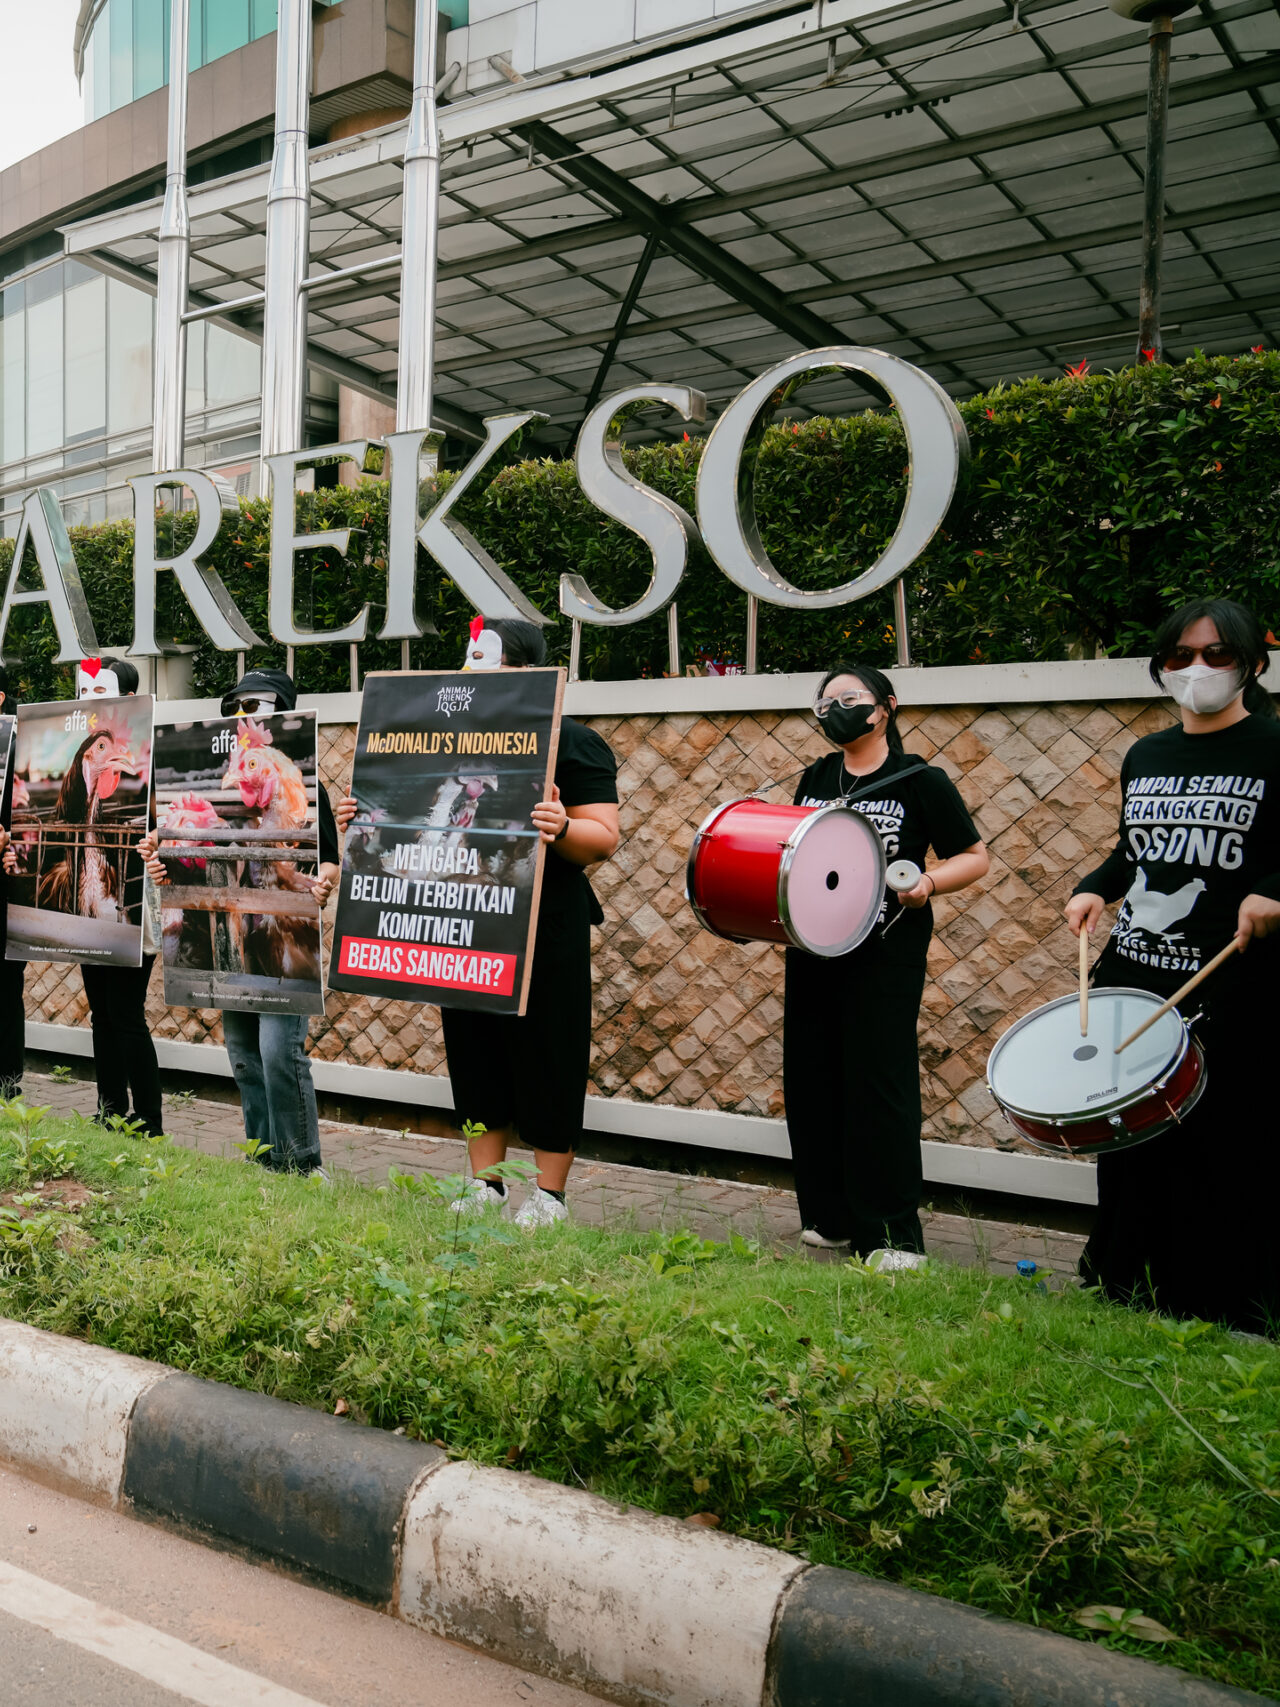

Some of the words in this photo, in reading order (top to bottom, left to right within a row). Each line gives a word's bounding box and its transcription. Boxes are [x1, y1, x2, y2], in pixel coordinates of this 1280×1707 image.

[126, 346, 970, 656] REKSO
[437, 686, 475, 695] ANIMAL
[438, 693, 472, 703] FRIENDS
[65, 710, 87, 731] affa
[435, 701, 469, 718] JOGJA
[211, 729, 237, 754] affa
[366, 732, 454, 754] McDONALD'S
[457, 732, 538, 755] INDONESIA
[1186, 775, 1265, 800] SEMUA
[1126, 800, 1251, 826] ERANGKENG
[393, 843, 478, 875] MENGAPA
[1126, 827, 1244, 870] OSONG
[350, 875, 411, 905] BELUM
[413, 879, 515, 915] TERBITKAN
[377, 911, 474, 947] KOMITMEN
[347, 942, 403, 974] BEBAS
[405, 949, 504, 987] SANGKAR?
